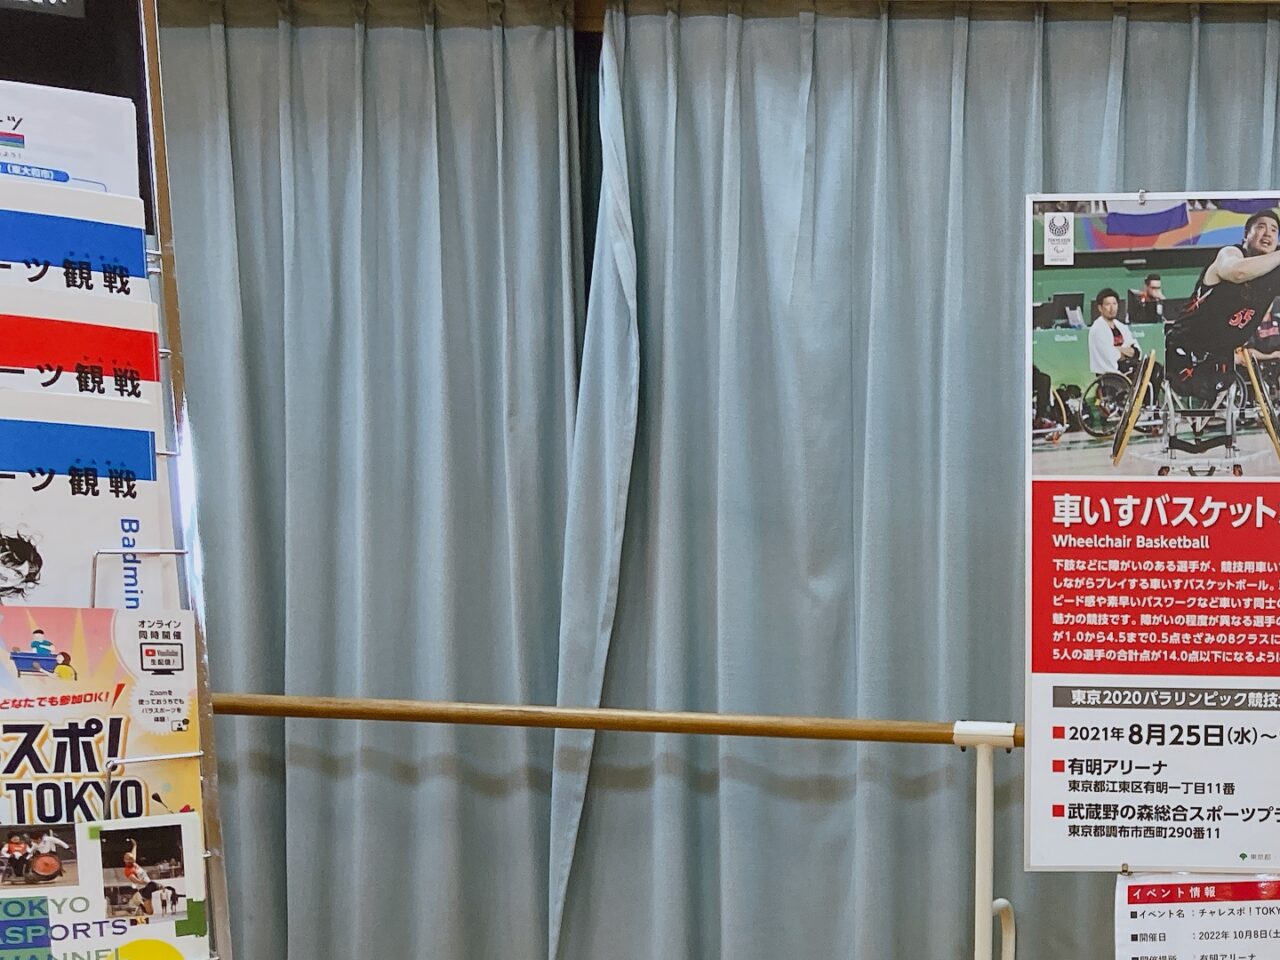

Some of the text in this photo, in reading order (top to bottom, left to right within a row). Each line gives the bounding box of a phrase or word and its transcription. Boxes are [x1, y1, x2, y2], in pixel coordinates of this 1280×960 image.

[1053, 534, 1210, 550] Wheelchair Basketball
[138, 619, 182, 629] オンライン
[1068, 758, 1168, 776] 有明アリーナ
[1068, 780, 1236, 795] 東京都江東区有明一丁目11番
[6, 779, 143, 825] TOKYO
[1068, 825, 1221, 840] 東京都調布市西町290番11
[1132, 886, 1217, 900] イベント情報
[0, 896, 90, 918] OKYO
[0, 919, 128, 946] SPORTS
[1139, 932, 1167, 943] 開催日
